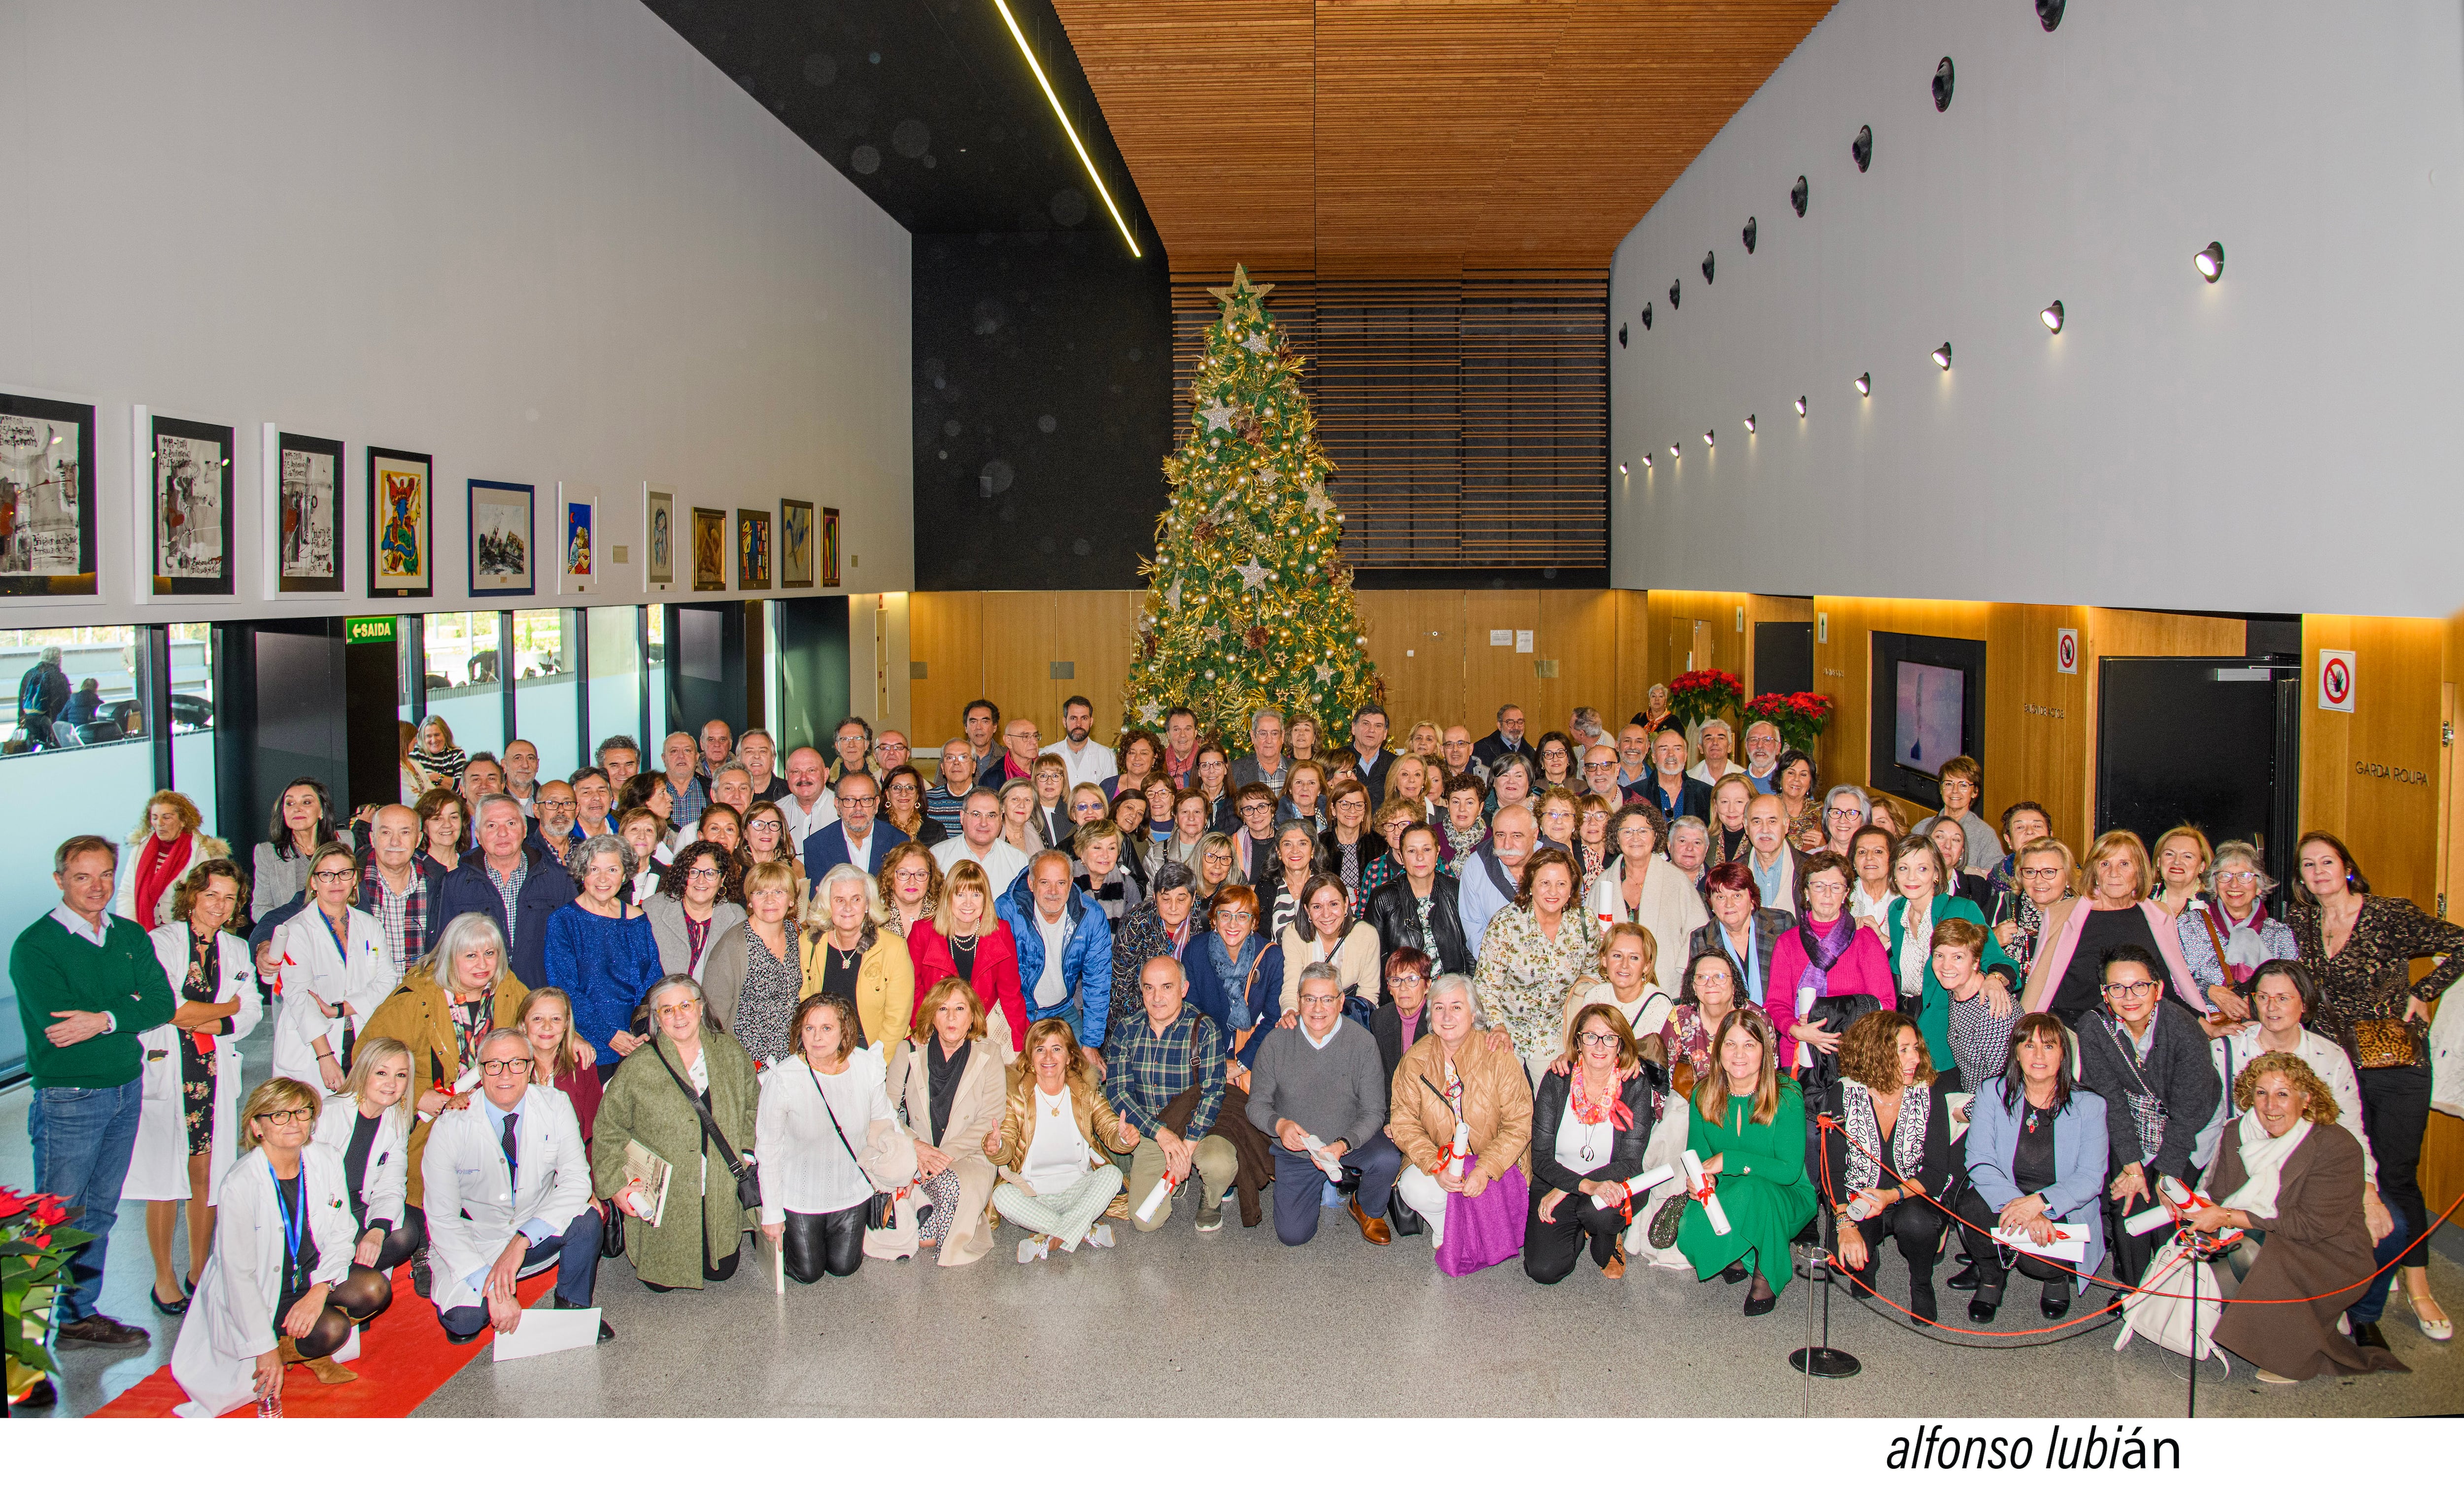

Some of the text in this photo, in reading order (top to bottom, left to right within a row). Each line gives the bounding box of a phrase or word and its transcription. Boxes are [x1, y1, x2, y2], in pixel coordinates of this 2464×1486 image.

[361, 622, 391, 637] SAIDA
[2356, 761, 2429, 787] GARDA ROUPA
